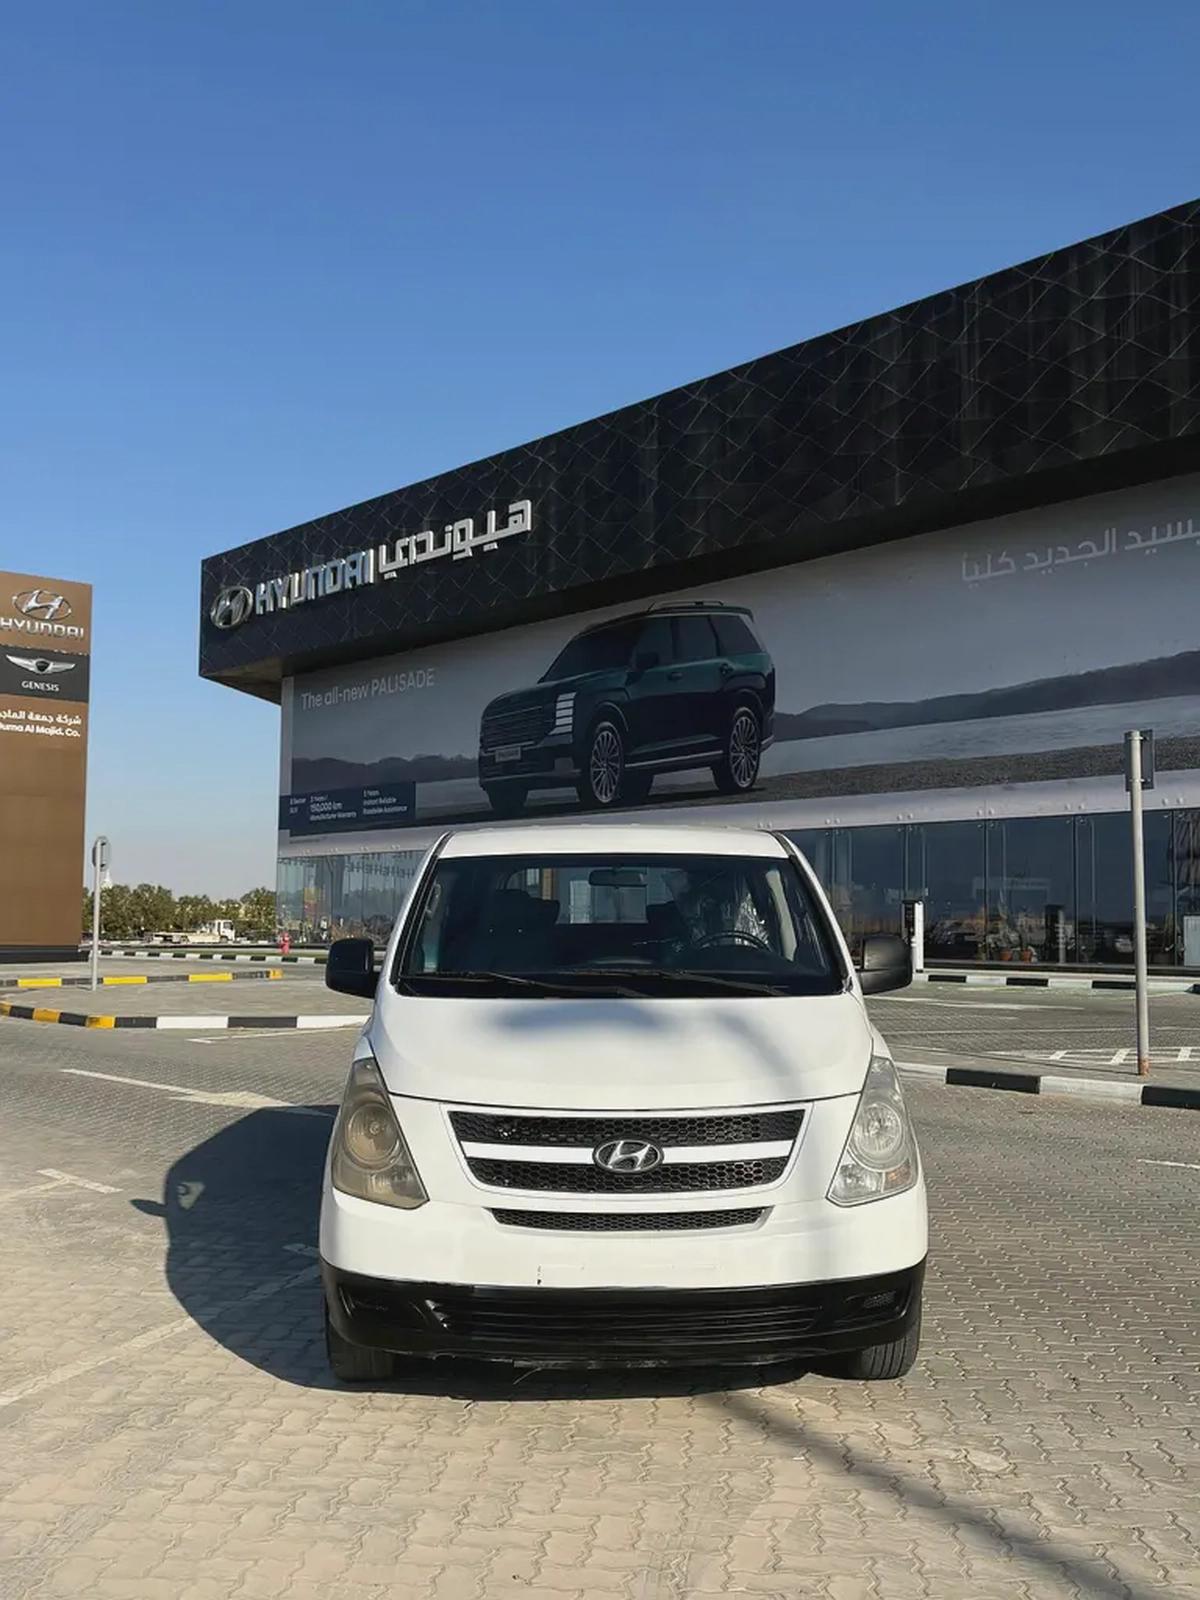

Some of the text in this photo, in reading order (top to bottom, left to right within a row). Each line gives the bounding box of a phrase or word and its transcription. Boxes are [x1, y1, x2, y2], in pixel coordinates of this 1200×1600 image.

[378, 499, 532, 580] هيونداي
[1023, 527, 1117, 575] الجديد
[255, 548, 375, 615] HYUNDAI
[0, 617, 84, 638] HYUNDAI
[21, 680, 60, 692] GENESIS
[301, 668, 435, 710] The all-new PALISADE
[0, 709, 82, 726] شركة جمعة الماج
[25, 723, 35, 732] Al
